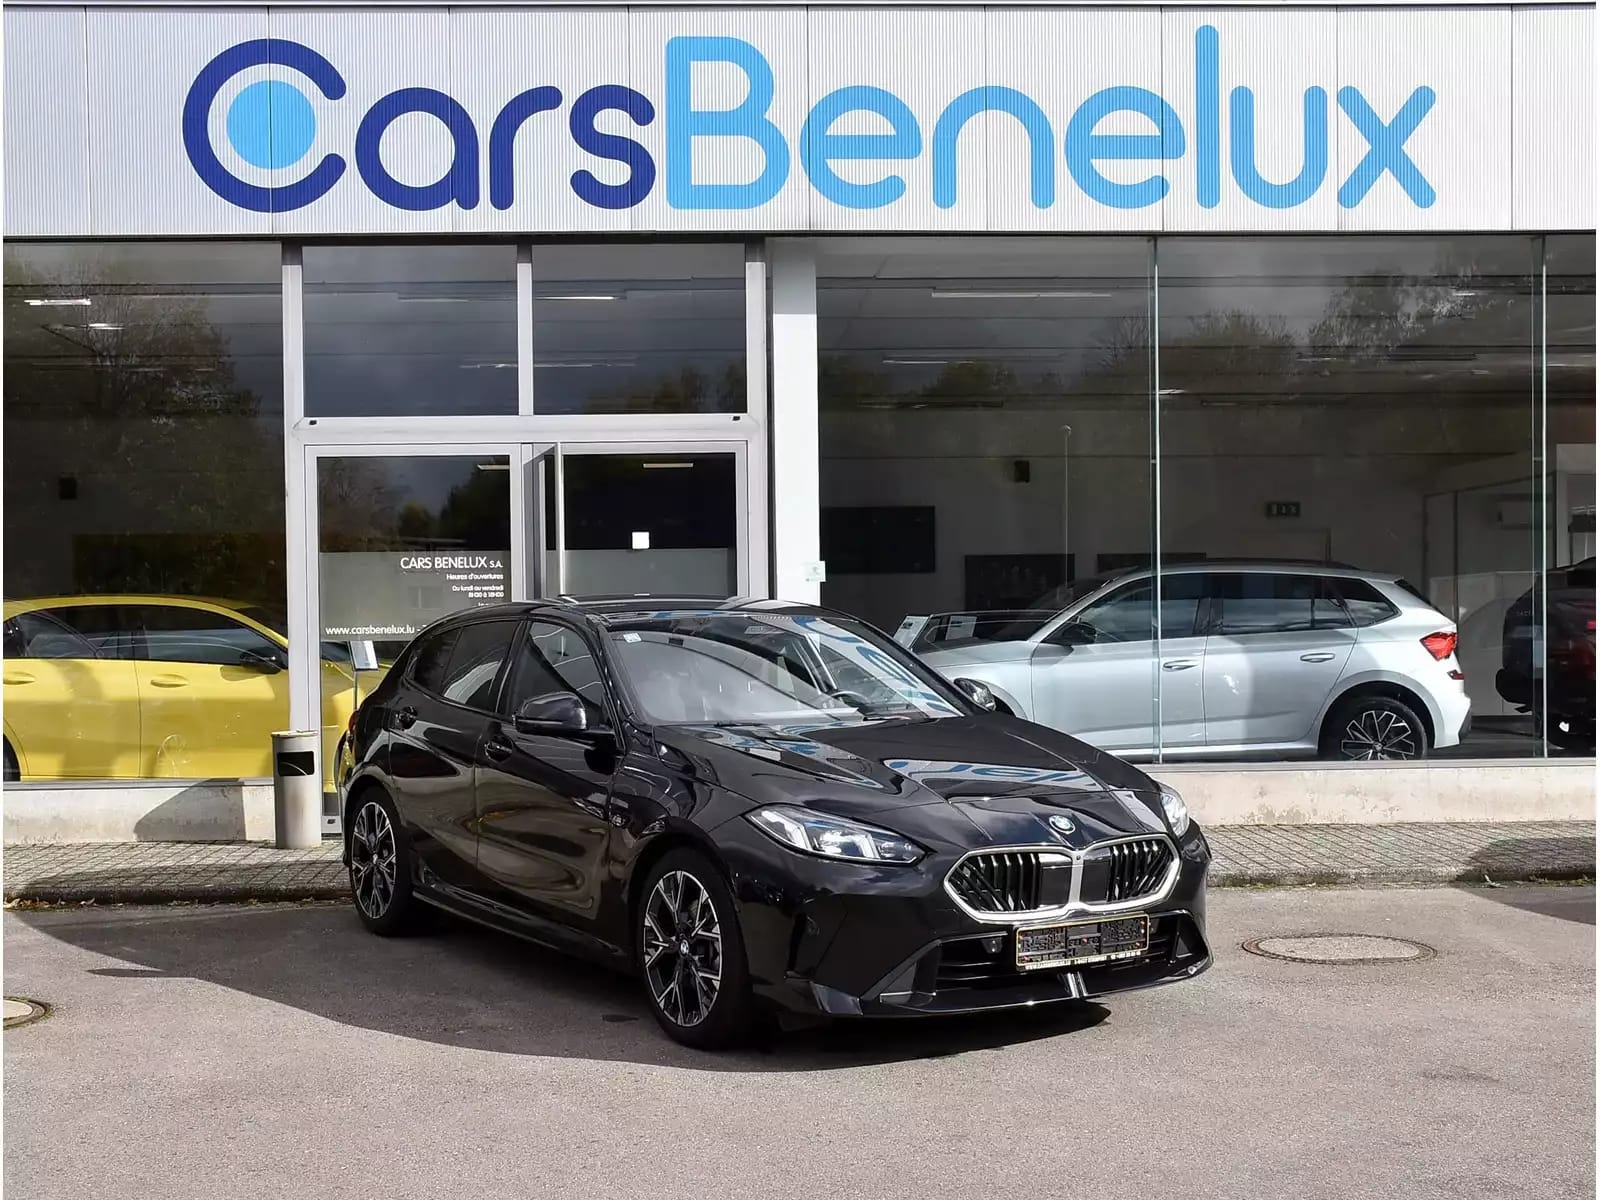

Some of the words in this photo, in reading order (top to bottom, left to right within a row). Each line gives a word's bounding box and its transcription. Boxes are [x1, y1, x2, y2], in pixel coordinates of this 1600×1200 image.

[400, 556, 432, 569] CARS
[435, 556, 487, 569] BENELUX
[325, 624, 415, 635] www.carsbenelux.lu
